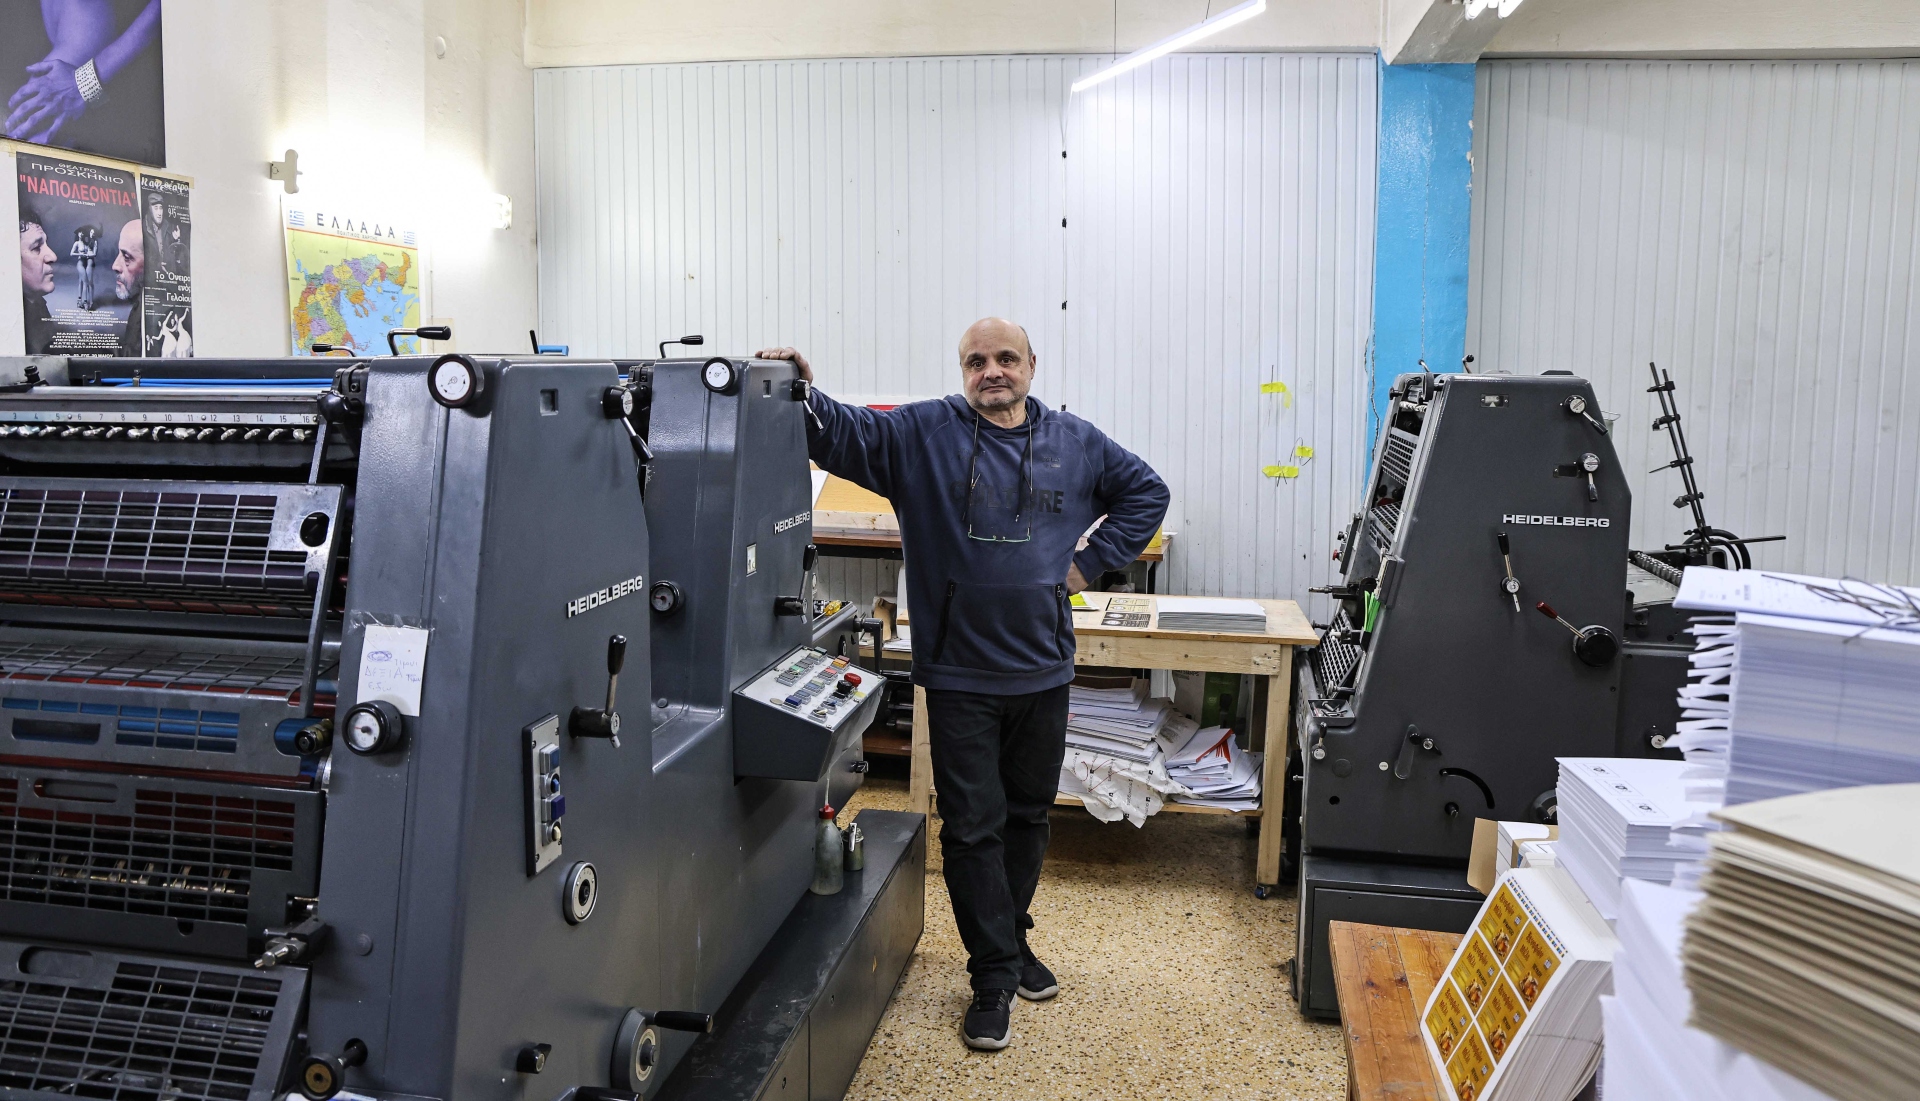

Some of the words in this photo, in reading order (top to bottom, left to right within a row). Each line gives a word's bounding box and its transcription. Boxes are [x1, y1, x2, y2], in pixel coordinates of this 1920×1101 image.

[32, 162, 123, 184] ΠΡΟΣΚΗΝΙΟ
[58, 162, 97, 173] ΘΕΑΤΡΟ
[20, 174, 136, 207] "ΝΑΠΟΛΕΟΝΤΙΑ"
[316, 213, 396, 238] ΕΛΛΑΔΑ
[155, 271, 165, 280] Το
[13, 412, 17, 420] 3
[77, 413, 82, 421] 6
[99, 413, 104, 421] 7
[164, 414, 173, 422] 10
[187, 414, 194, 422] 11
[210, 414, 217, 422] 12
[256, 415, 264, 423] 14
[279, 415, 287, 423] 15
[302, 416, 310, 424] 16
[774, 511, 811, 535] HEIDELBERG
[1502, 514, 1610, 528] HEIDELBERG
[567, 575, 643, 618] HEIDELBERG
